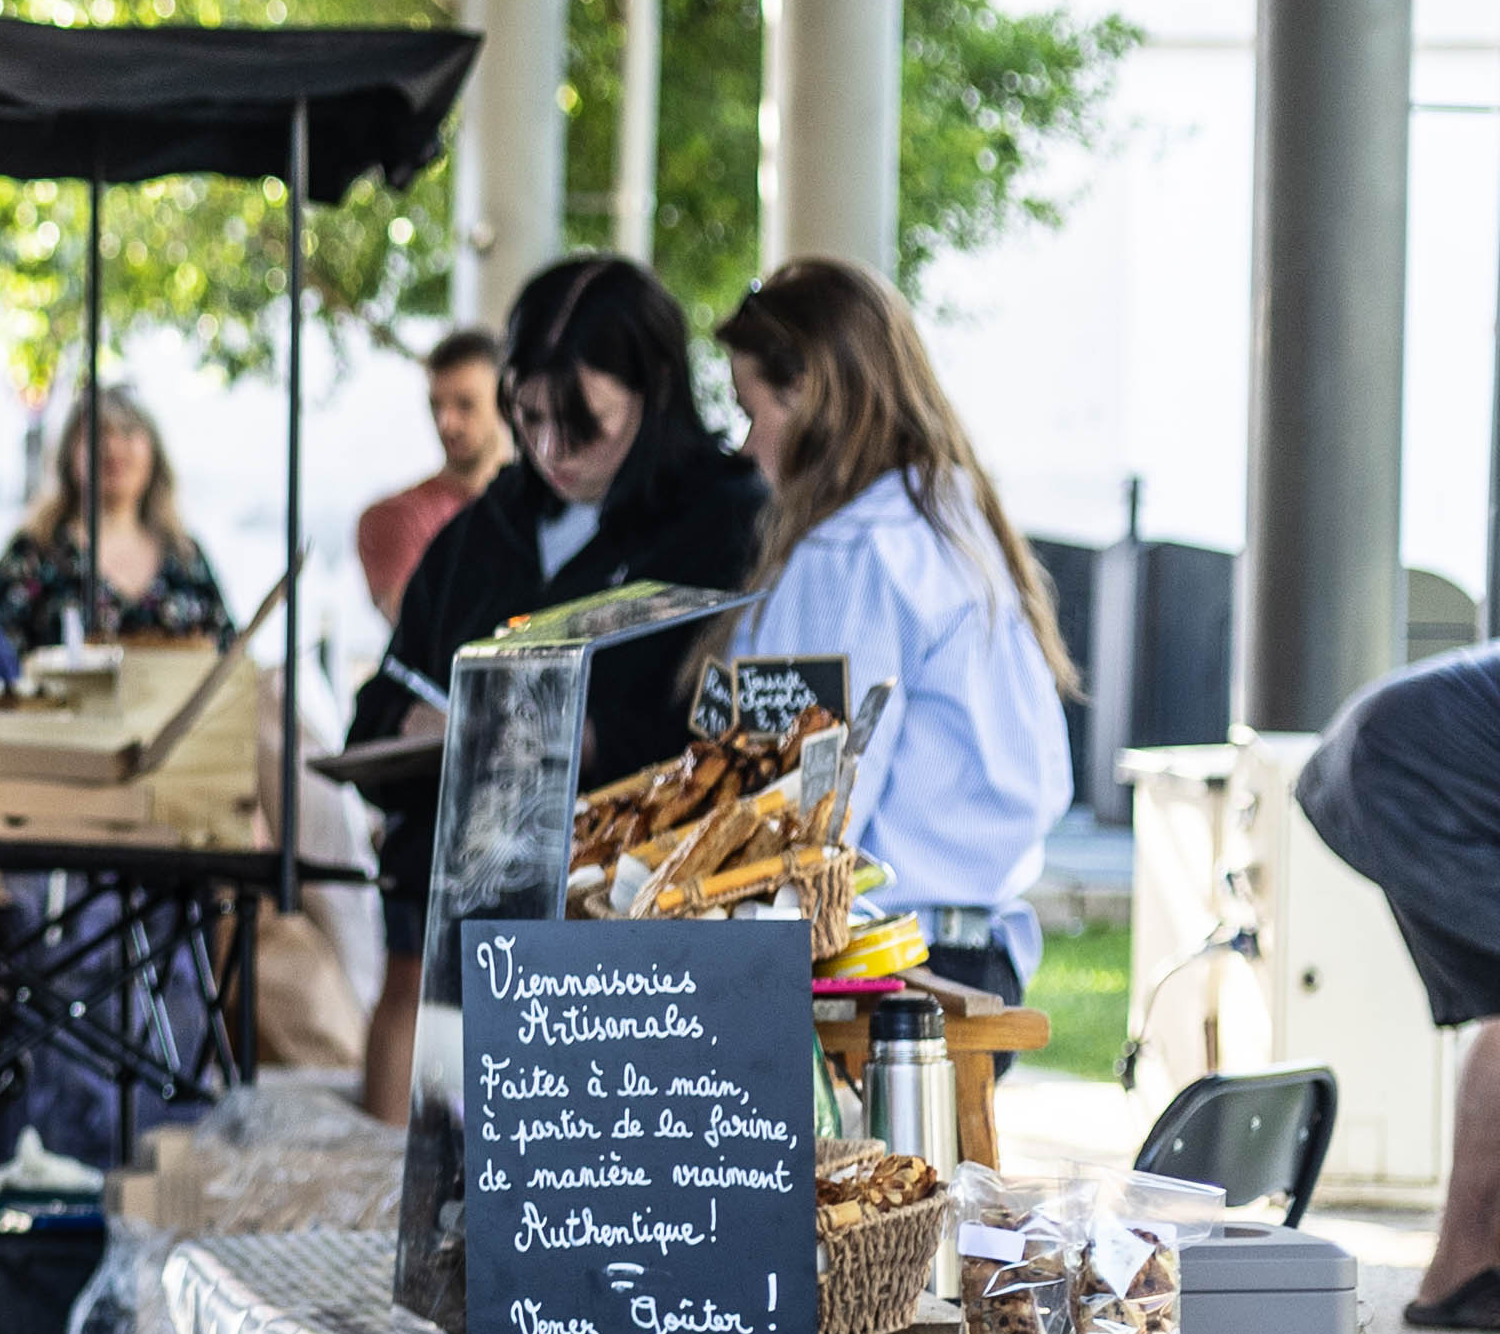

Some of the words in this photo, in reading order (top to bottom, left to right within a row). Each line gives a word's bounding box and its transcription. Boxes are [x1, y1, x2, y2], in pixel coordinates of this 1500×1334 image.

[476, 935, 697, 1002] Viennoiseries
[479, 1053, 570, 1101] Faites
[587, 1060, 608, 1098] à
[616, 1062, 659, 1098] la
[665, 1075, 750, 1105] main,
[482, 1104, 502, 1142] à
[510, 1109, 602, 1156] partir
[611, 1107, 645, 1139] de
[653, 1108, 694, 1139] la
[704, 1104, 797, 1150] farine,
[478, 1158, 512, 1192] de
[526, 1150, 652, 1191] manière
[672, 1157, 793, 1193] vraiment
